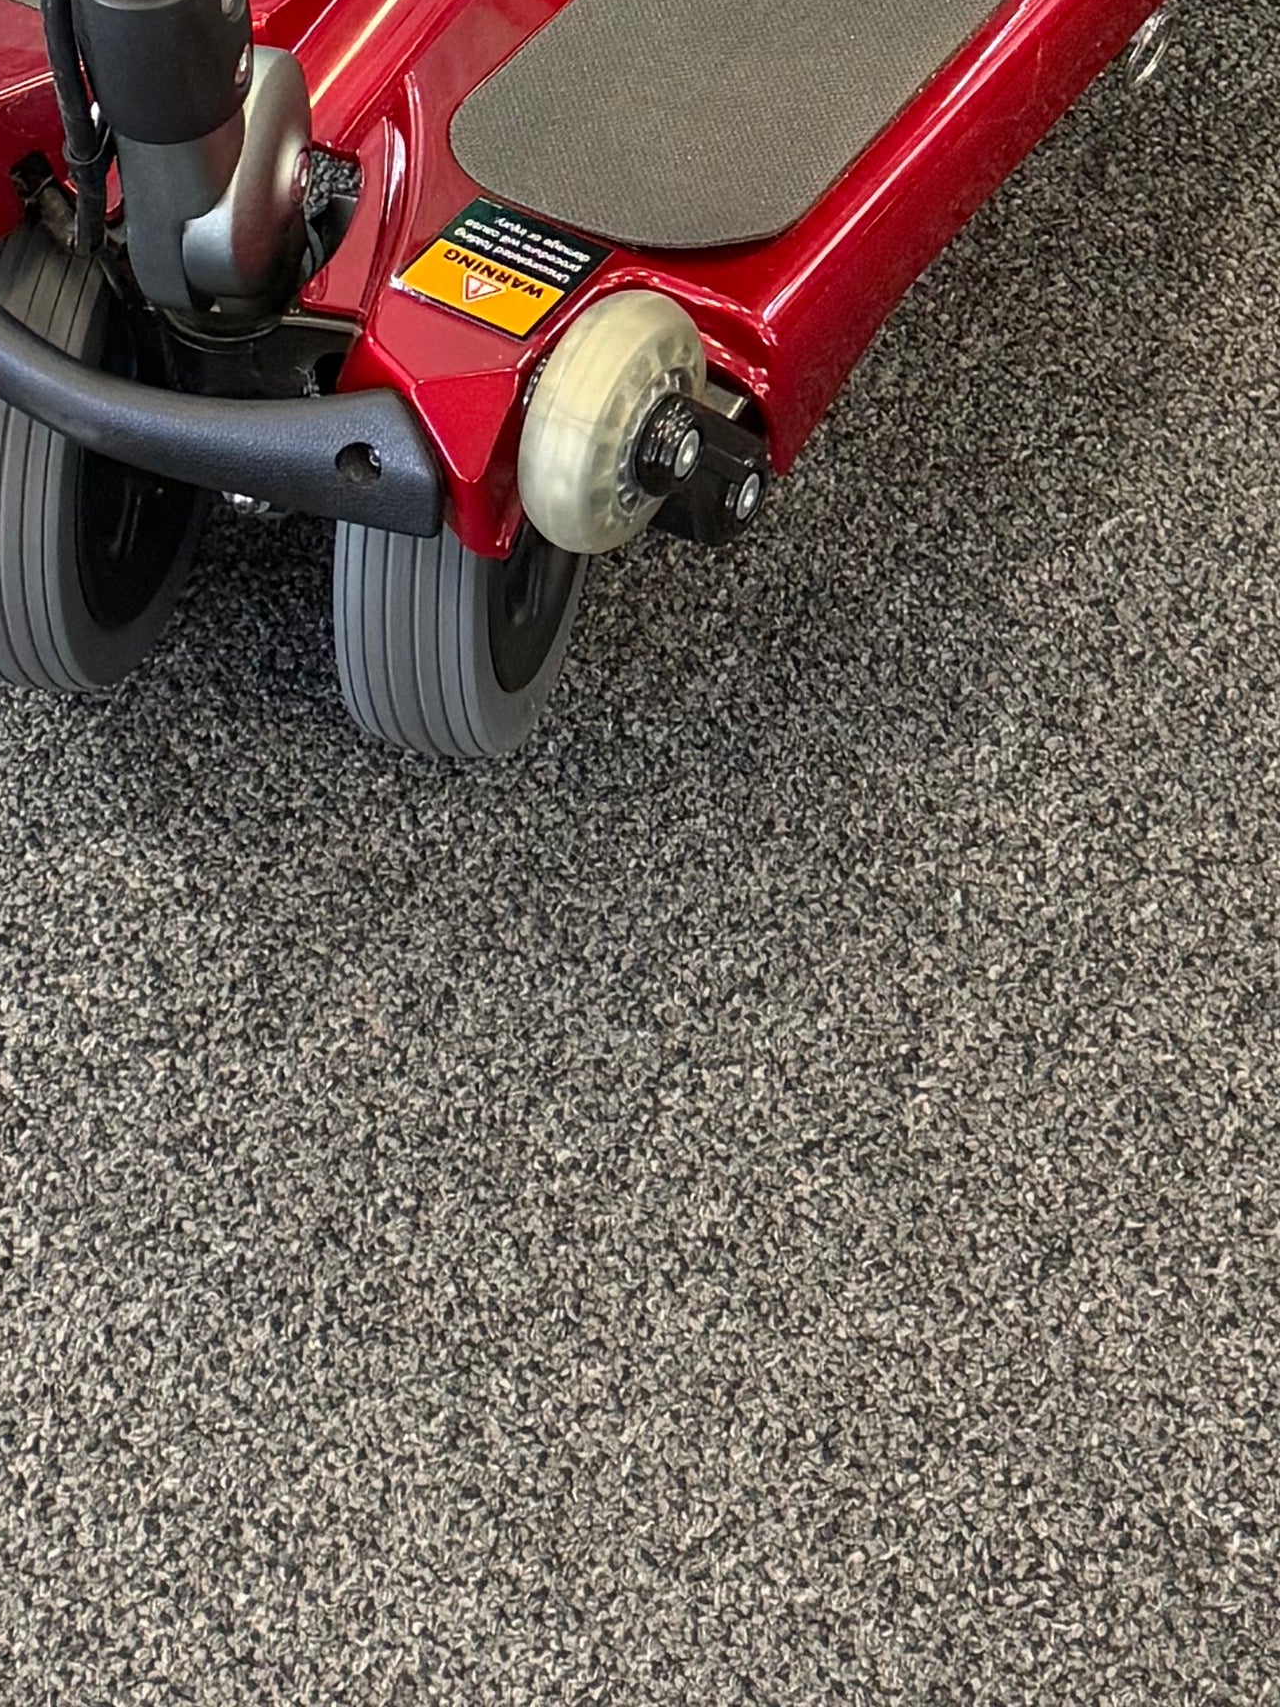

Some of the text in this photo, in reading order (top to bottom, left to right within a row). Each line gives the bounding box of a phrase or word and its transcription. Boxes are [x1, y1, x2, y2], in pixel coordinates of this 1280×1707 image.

[454, 228, 570, 284] Uncompleted folding
[464, 219, 582, 272] procedure will cause
[527, 231, 542, 241] or
[543, 238, 590, 263] damage
[444, 251, 543, 298] WARNING
